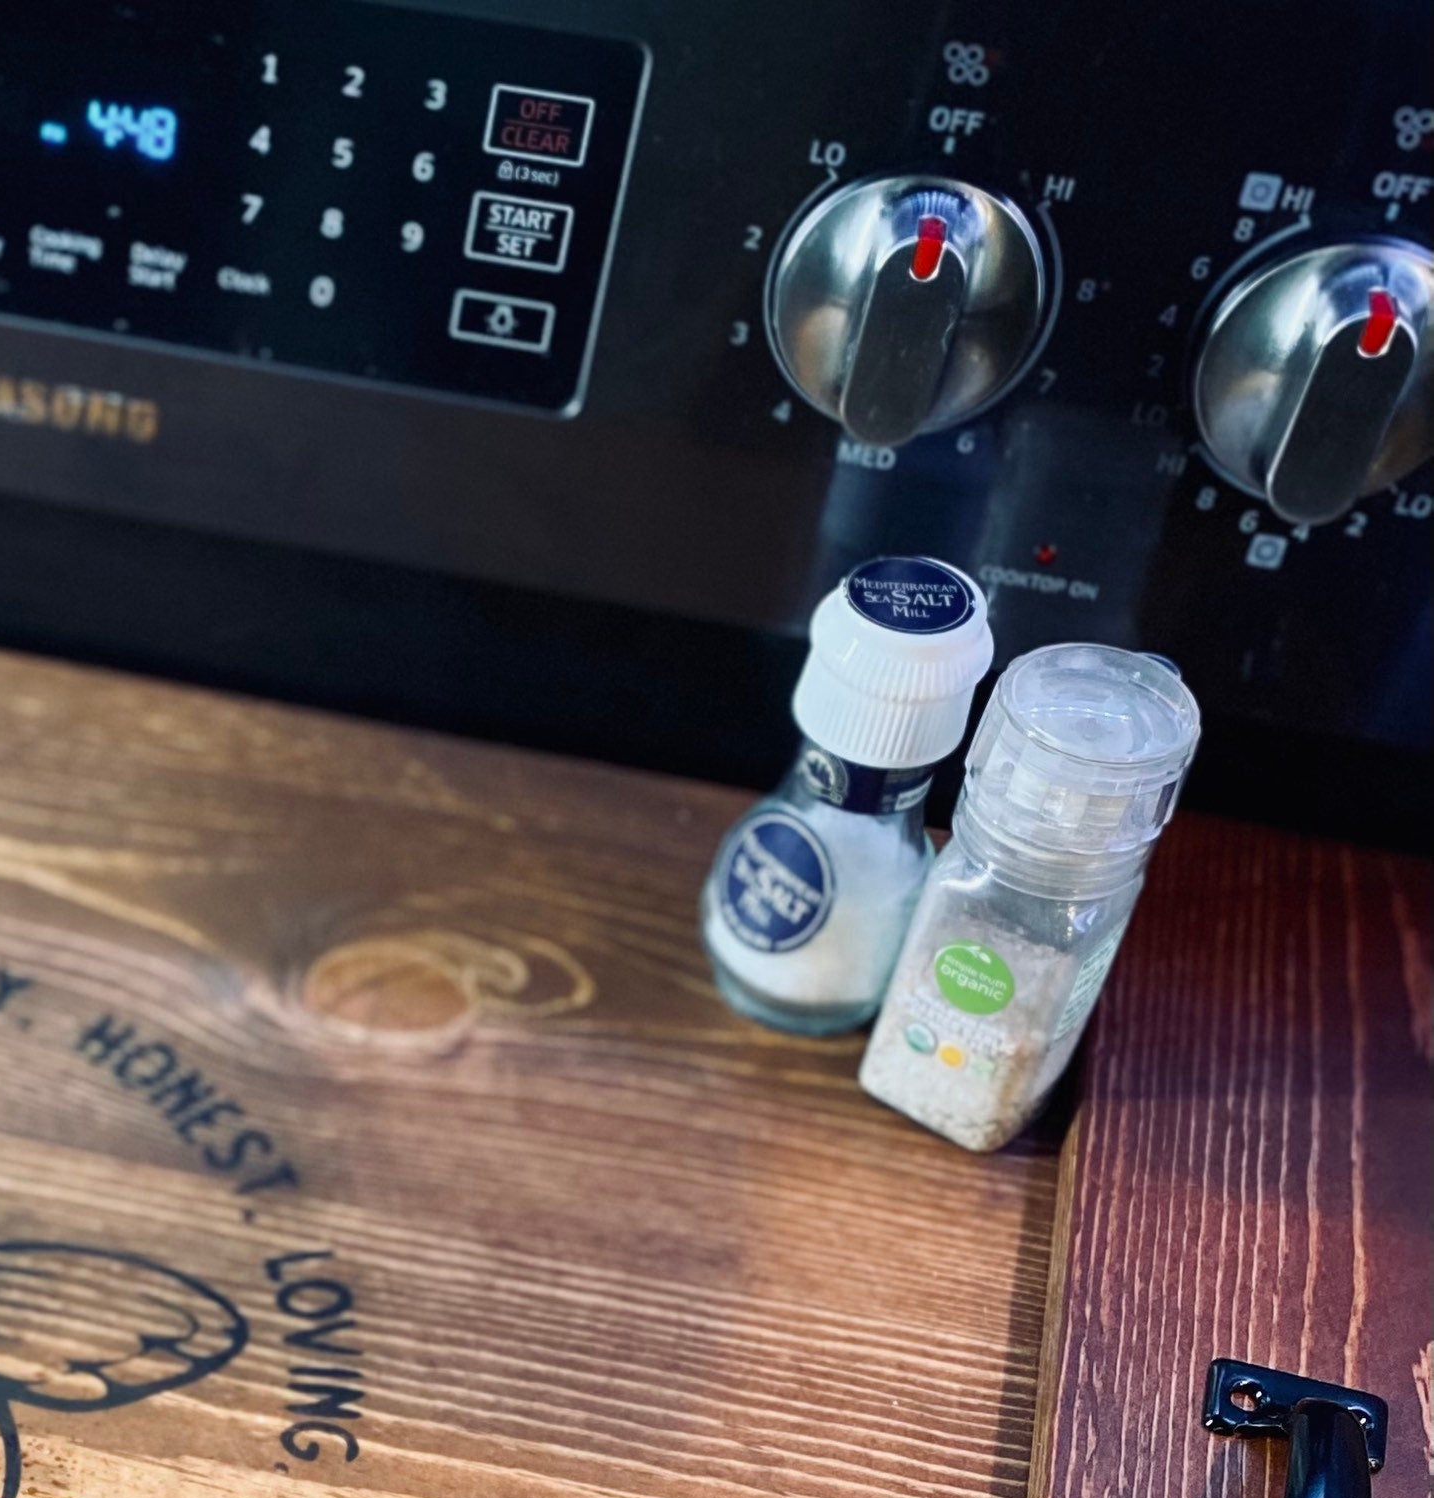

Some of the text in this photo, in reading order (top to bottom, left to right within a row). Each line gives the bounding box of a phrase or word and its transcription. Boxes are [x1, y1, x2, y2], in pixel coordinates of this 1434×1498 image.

[261, 53, 279, 85] 1
[341, 65, 366, 98] 2
[423, 78, 449, 111] 3
[518, 98, 563, 123] OFF
[928, 106, 986, 137] OFF
[248, 124, 272, 156] 4
[331, 136, 355, 170] 5
[500, 125, 571, 154] CLEAR
[809, 139, 847, 168] LO
[411, 150, 436, 183] 6
[1042, 173, 1077, 202] HI
[1280, 184, 1315, 214] HI
[1371, 171, 1433, 203] OFF
[240, 192, 264, 226] 7
[319, 206, 345, 240] 8
[488, 203, 555, 232] START
[29, 224, 104, 261] Cooking
[400, 220, 425, 254] 9
[742, 225, 764, 251] 2
[1233, 216, 1256, 243] 8
[29, 244, 77, 275] Time
[129, 241, 188, 273] Delay
[496, 232, 537, 258] SET
[128, 262, 176, 292] Start
[217, 265, 271, 295] Clock
[1190, 255, 1211, 282] 6
[308, 274, 336, 309] 0
[1076, 278, 1095, 302] 8
[1158, 304, 1178, 328] 4
[729, 321, 749, 346] 3
[1146, 354, 1165, 378] 2
[1039, 368, 1058, 395] 7
[772, 400, 793, 425] 4
[836, 439, 897, 471] MED
[956, 431, 976, 454] 6
[1195, 486, 1218, 511] 8
[1394, 491, 1433, 520] LO
[1238, 508, 1260, 535] 6
[1344, 511, 1368, 537] 2
[979, 564, 1100, 601] COOKTOP ON
[940, 964, 1004, 1001] organic
[944, 955, 1007, 992] simple truth
